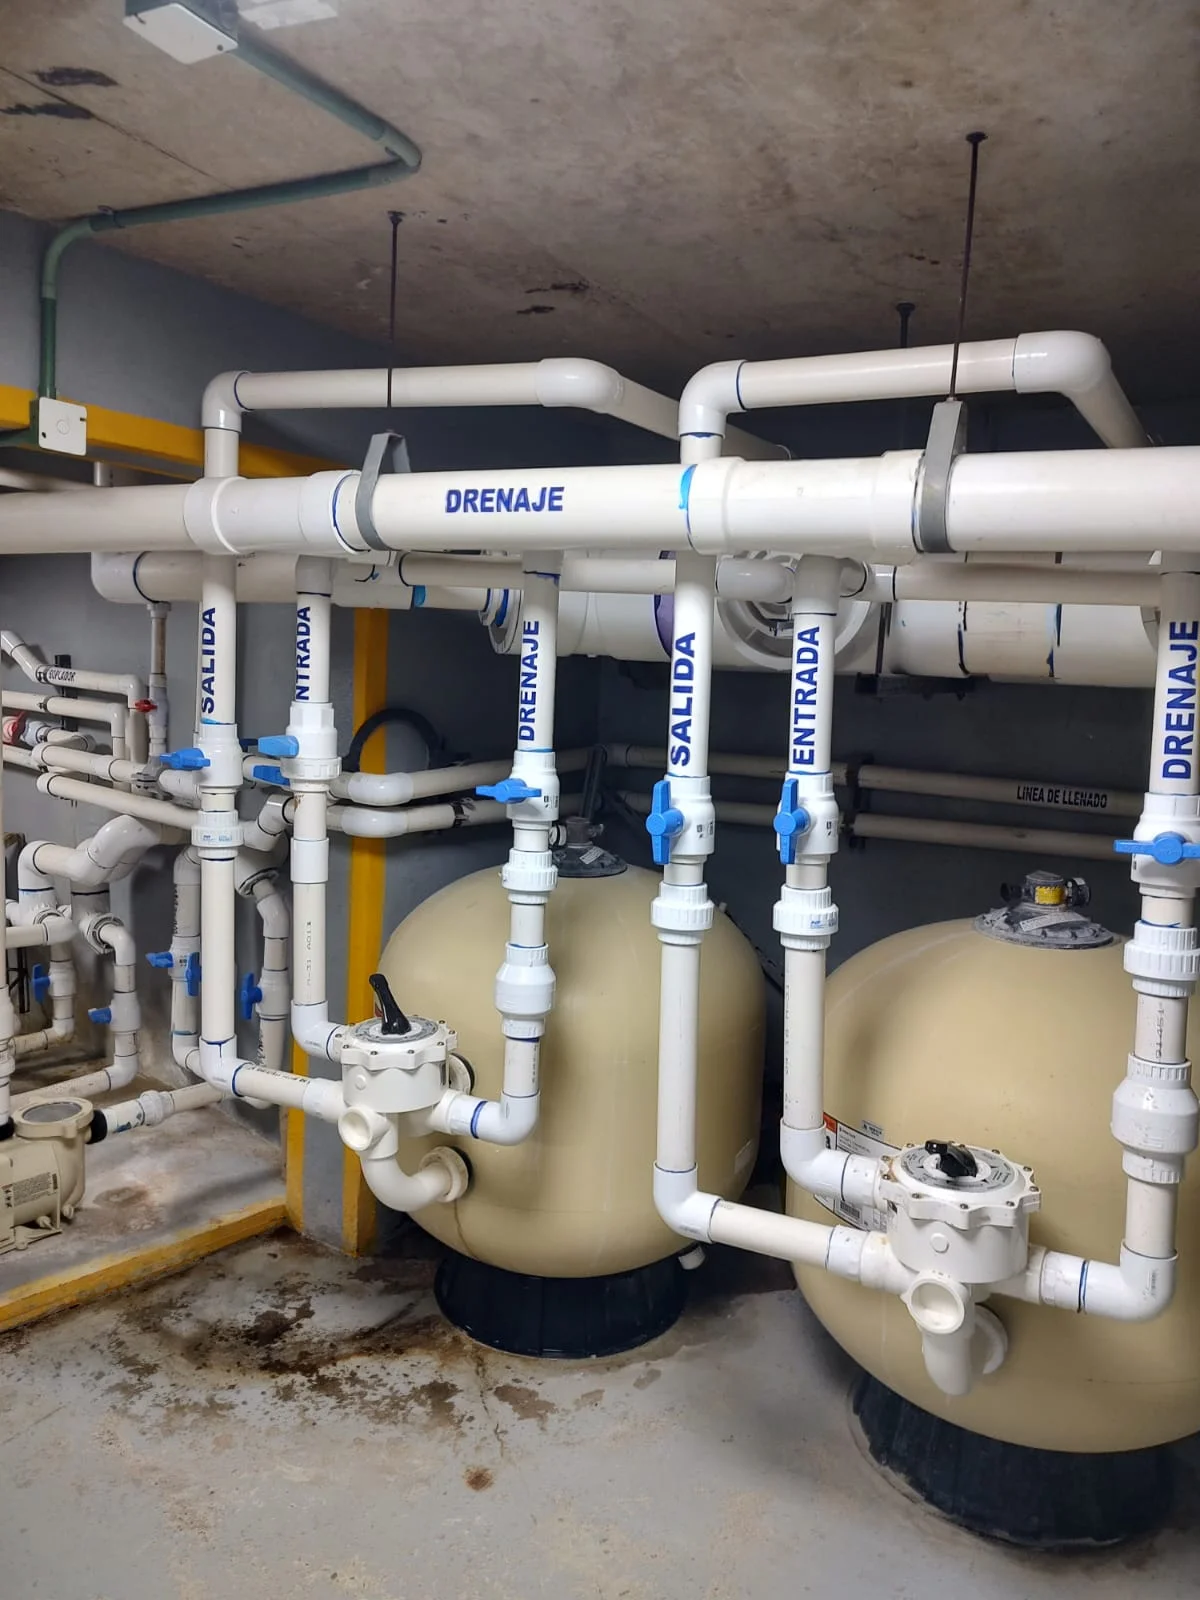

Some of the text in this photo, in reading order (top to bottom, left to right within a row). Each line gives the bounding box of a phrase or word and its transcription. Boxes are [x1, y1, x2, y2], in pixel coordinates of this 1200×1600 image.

[446, 485, 564, 514] DRENAJE
[200, 607, 216, 714] SALIDA
[295, 606, 311, 701] NTRADA
[518, 619, 540, 742] DRENAJE
[670, 631, 697, 767] SALIDA
[792, 625, 821, 766] ENTRADA
[1162, 622, 1199, 780] DRENAJE
[1047, 788, 1061, 804] DE
[1062, 790, 1108, 809] LLENADO
